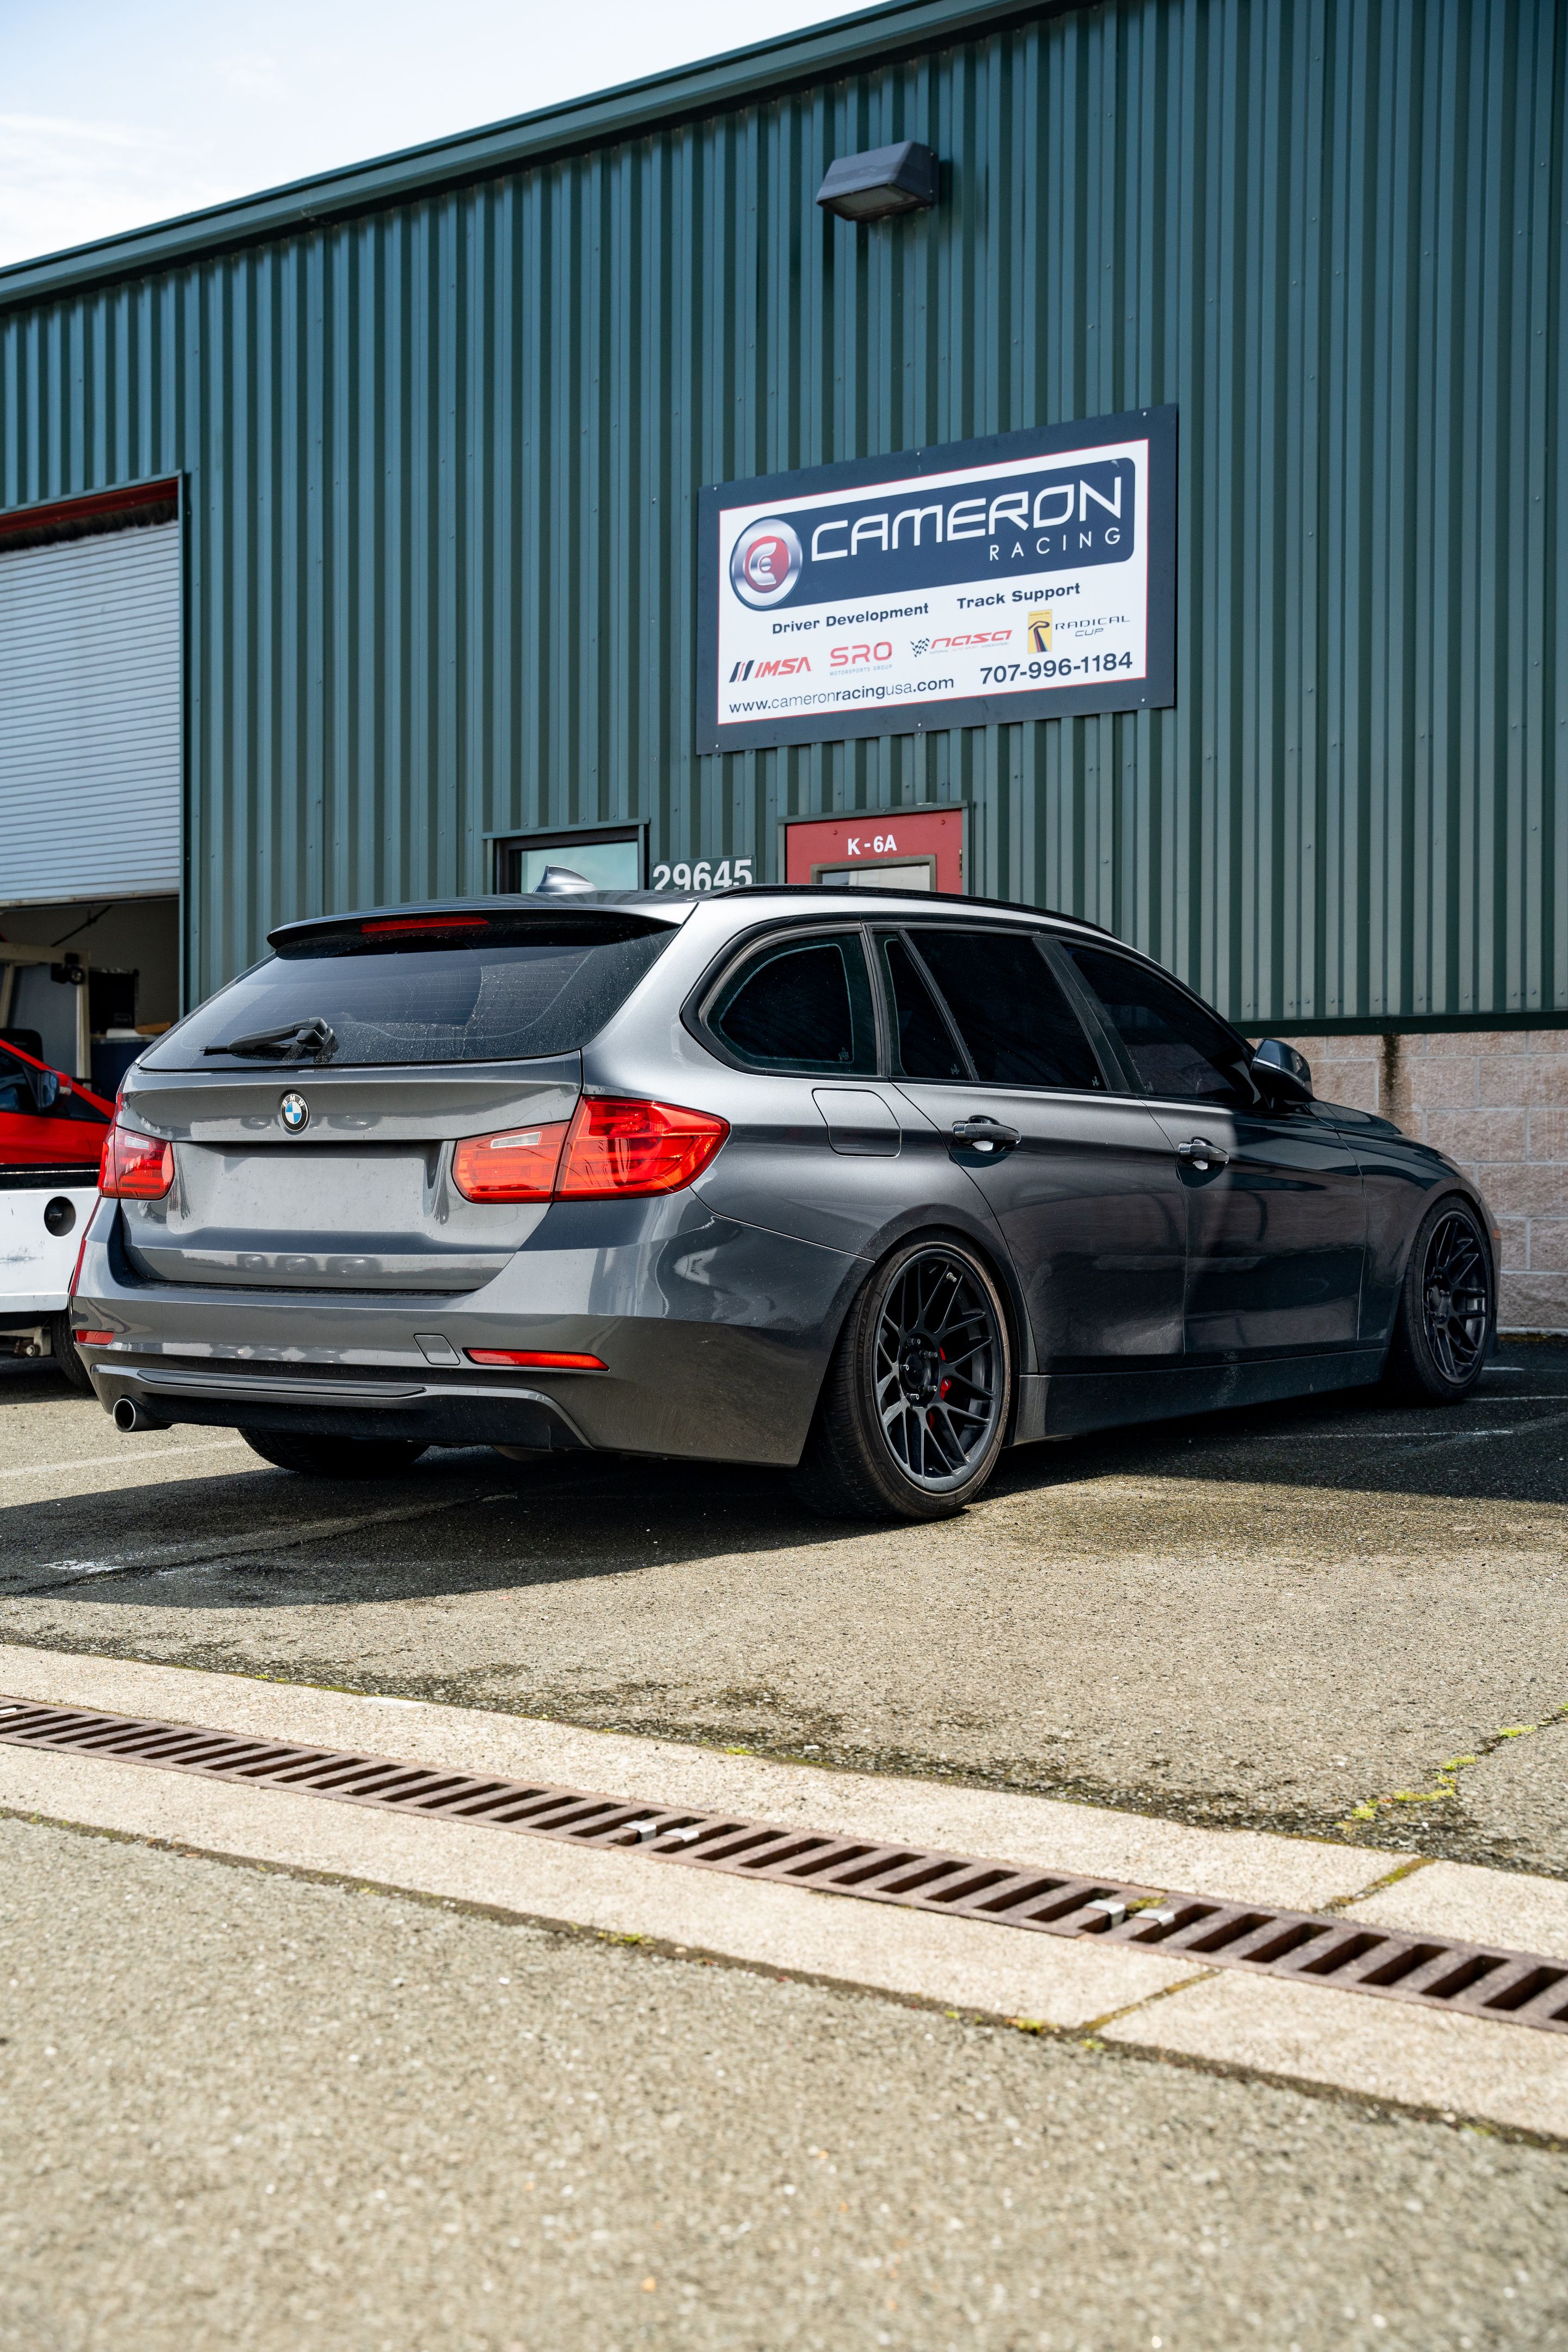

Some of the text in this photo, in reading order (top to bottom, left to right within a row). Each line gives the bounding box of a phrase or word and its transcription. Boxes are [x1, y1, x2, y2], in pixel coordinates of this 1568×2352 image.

[811, 476, 1122, 562] CAMERON
[989, 527, 1121, 561] RACING
[957, 583, 1080, 609] Track Support
[772, 603, 929, 634] Driver Development
[1055, 615, 1130, 630] RADICAL
[1075, 628, 1104, 637] CUP
[830, 641, 892, 667] SRO
[754, 657, 811, 678] IMSA
[829, 667, 871, 676] MOTORSPORTS
[979, 651, 1133, 685] 707-996-1184
[729, 678, 954, 714] www.cameronracingusa.com
[653, 859, 753, 890] 29645
[283, 1094, 305, 1107] BMW
